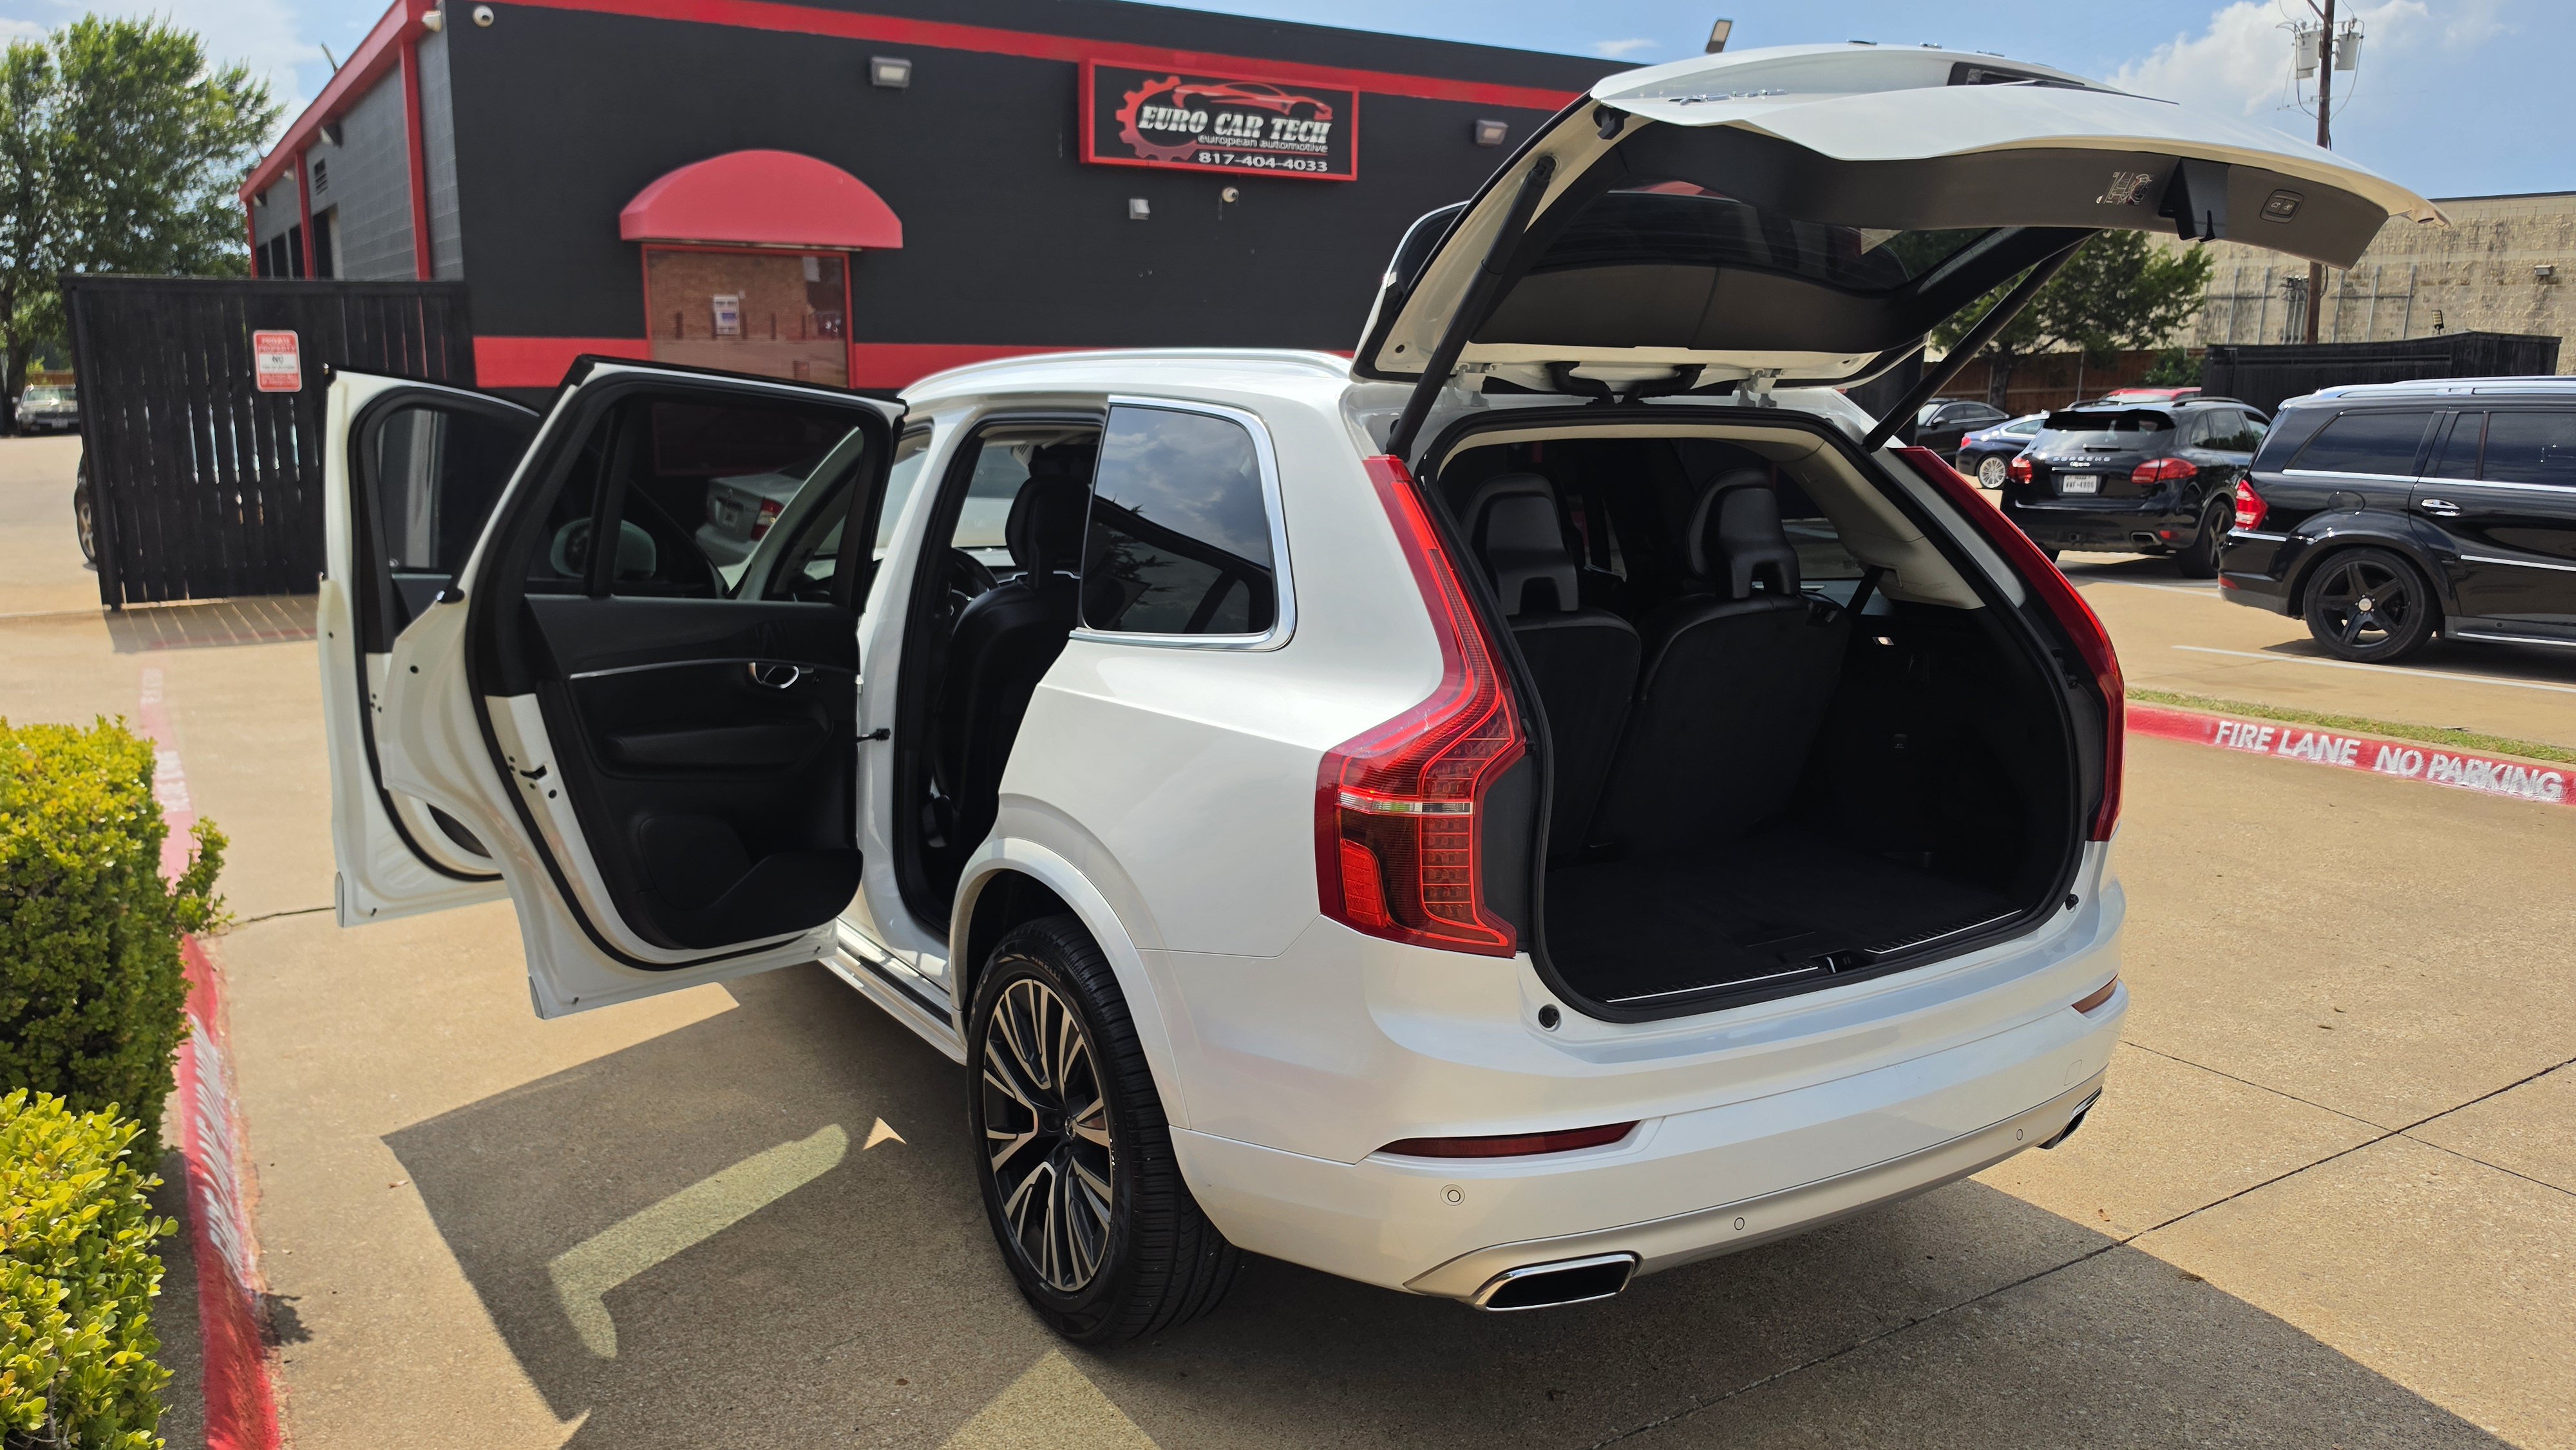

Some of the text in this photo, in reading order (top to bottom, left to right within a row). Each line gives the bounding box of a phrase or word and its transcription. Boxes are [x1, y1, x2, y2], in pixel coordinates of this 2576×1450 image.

[1138, 106, 1332, 144] EURO CAR TECH
[1198, 134, 1329, 153] european automotive
[1198, 152, 1328, 172] 817-404-4033
[2215, 720, 2564, 802] FIRE LANE NO PARKING
